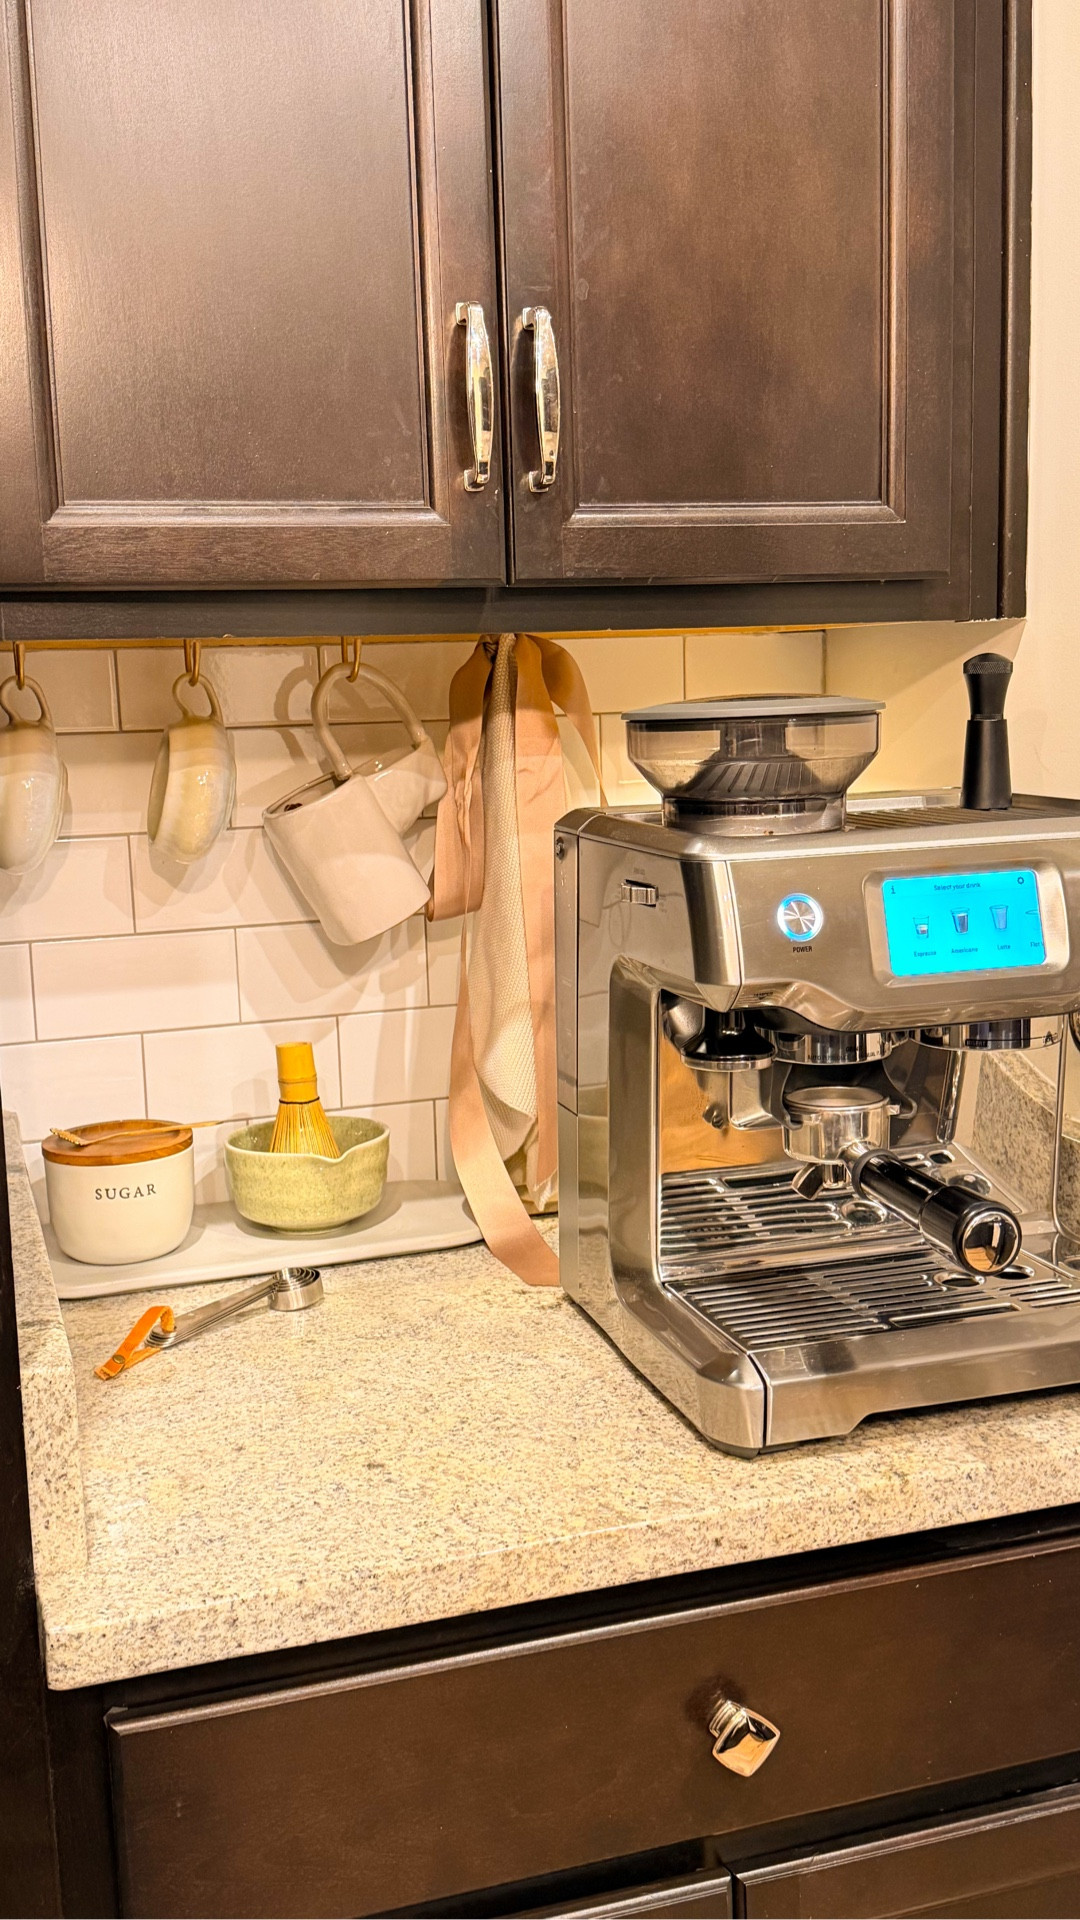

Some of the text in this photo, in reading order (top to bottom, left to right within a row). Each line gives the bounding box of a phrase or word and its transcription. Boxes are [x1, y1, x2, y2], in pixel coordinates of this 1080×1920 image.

[913, 950, 937, 958] Espresso
[951, 946, 978, 954] Americano
[95, 1183, 156, 1200] SUGAR
